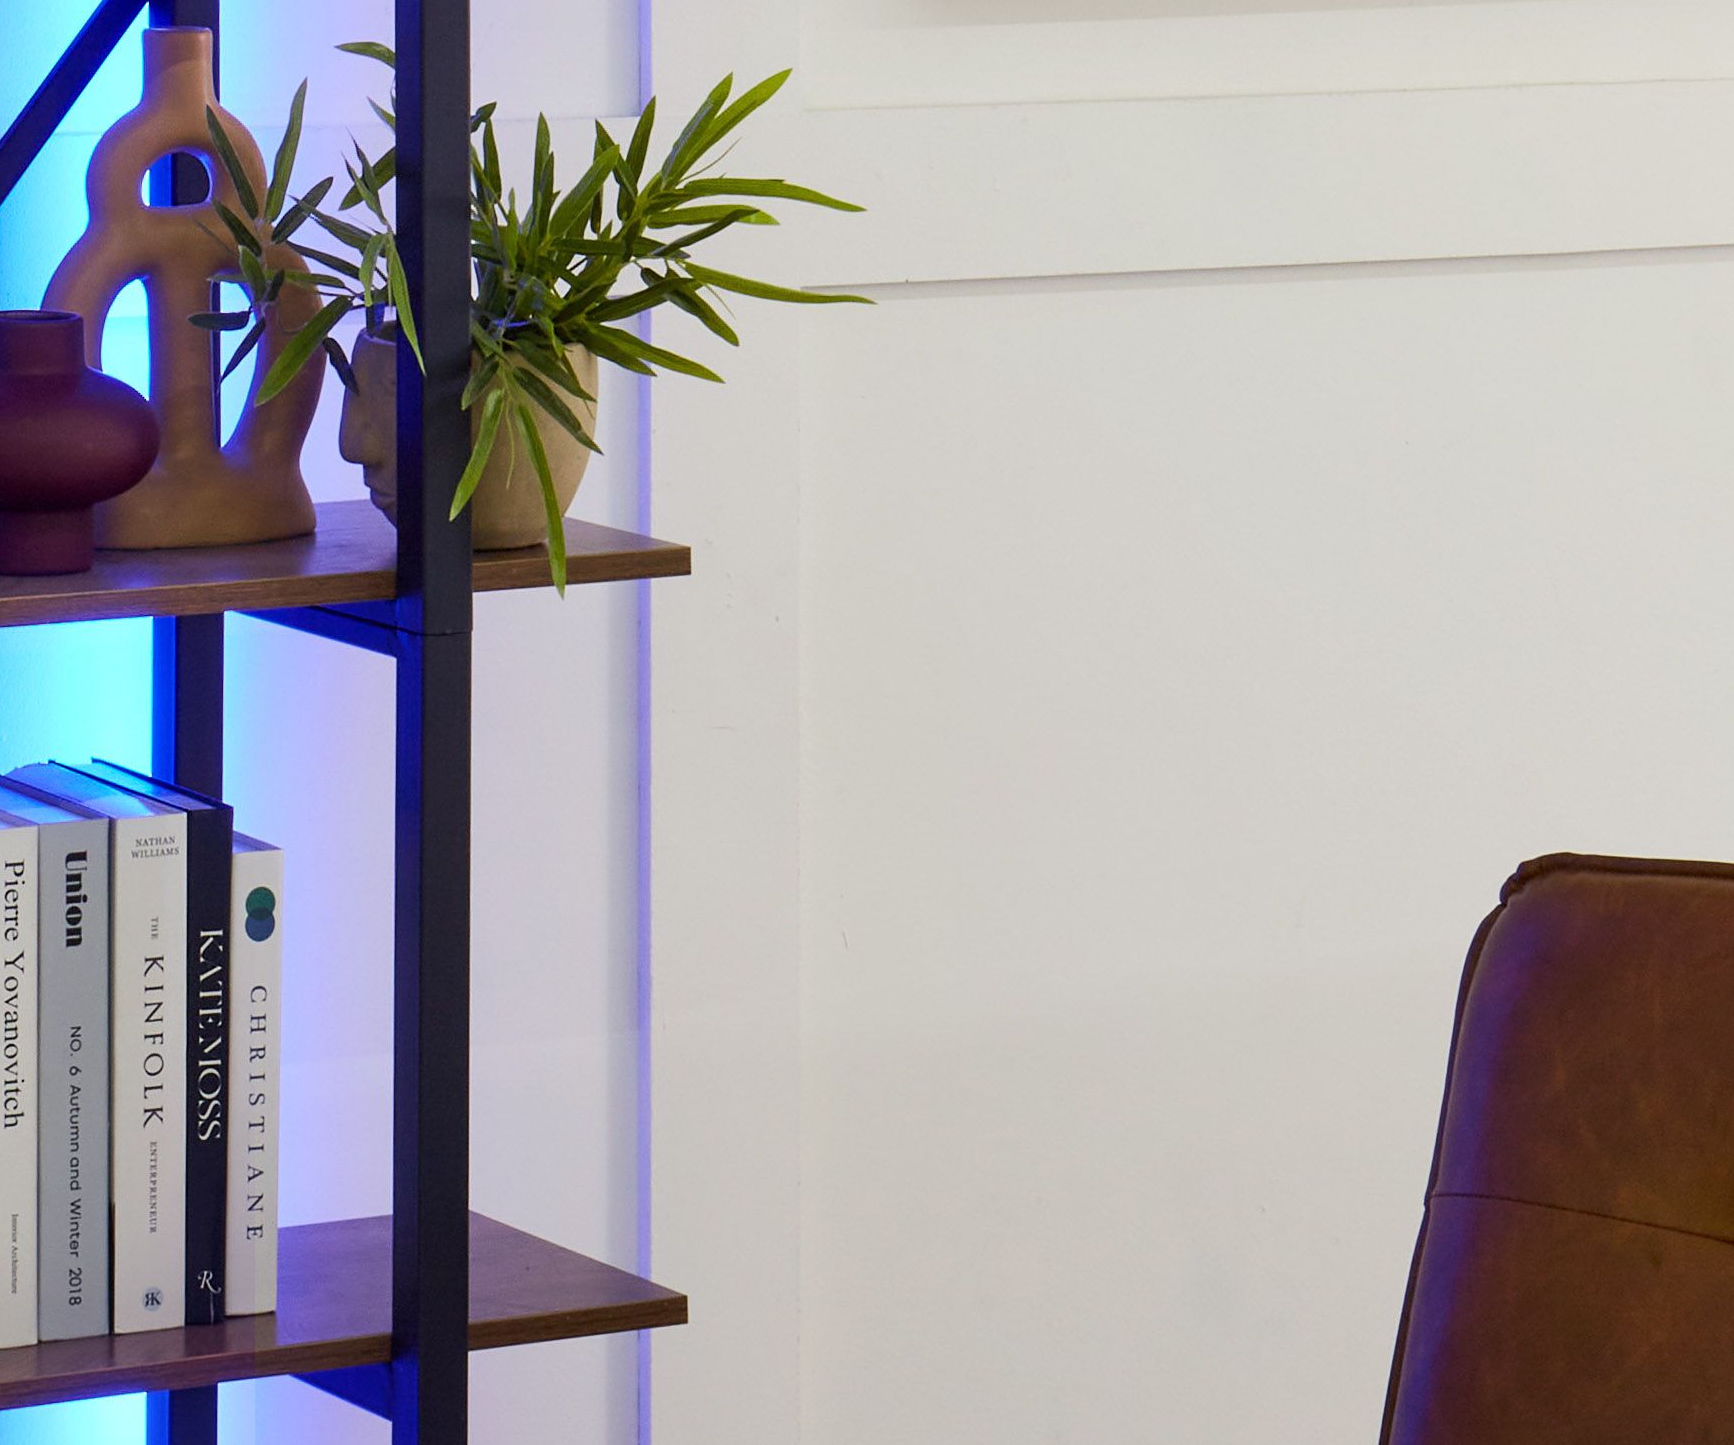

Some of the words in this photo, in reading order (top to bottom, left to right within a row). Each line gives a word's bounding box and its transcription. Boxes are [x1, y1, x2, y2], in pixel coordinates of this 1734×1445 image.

[131, 847, 179, 858] WILLIAMS
[135, 836, 175, 847] NATHAN
[4, 860, 26, 941] Pierre
[65, 851, 87, 947] Union
[150, 916, 159, 940] THE
[4, 951, 24, 1128] Yovanovitch
[69, 1025, 82, 1057] NO.
[143, 956, 164, 1128] KINFOLK
[69, 1066, 81, 1076] 6
[69, 1084, 82, 1153] Autumn
[247, 986, 266, 1240] CHRISTIANE
[69, 1156, 82, 1192] and
[69, 1198, 82, 1258] Winter
[69, 1268, 82, 1306] 2018
